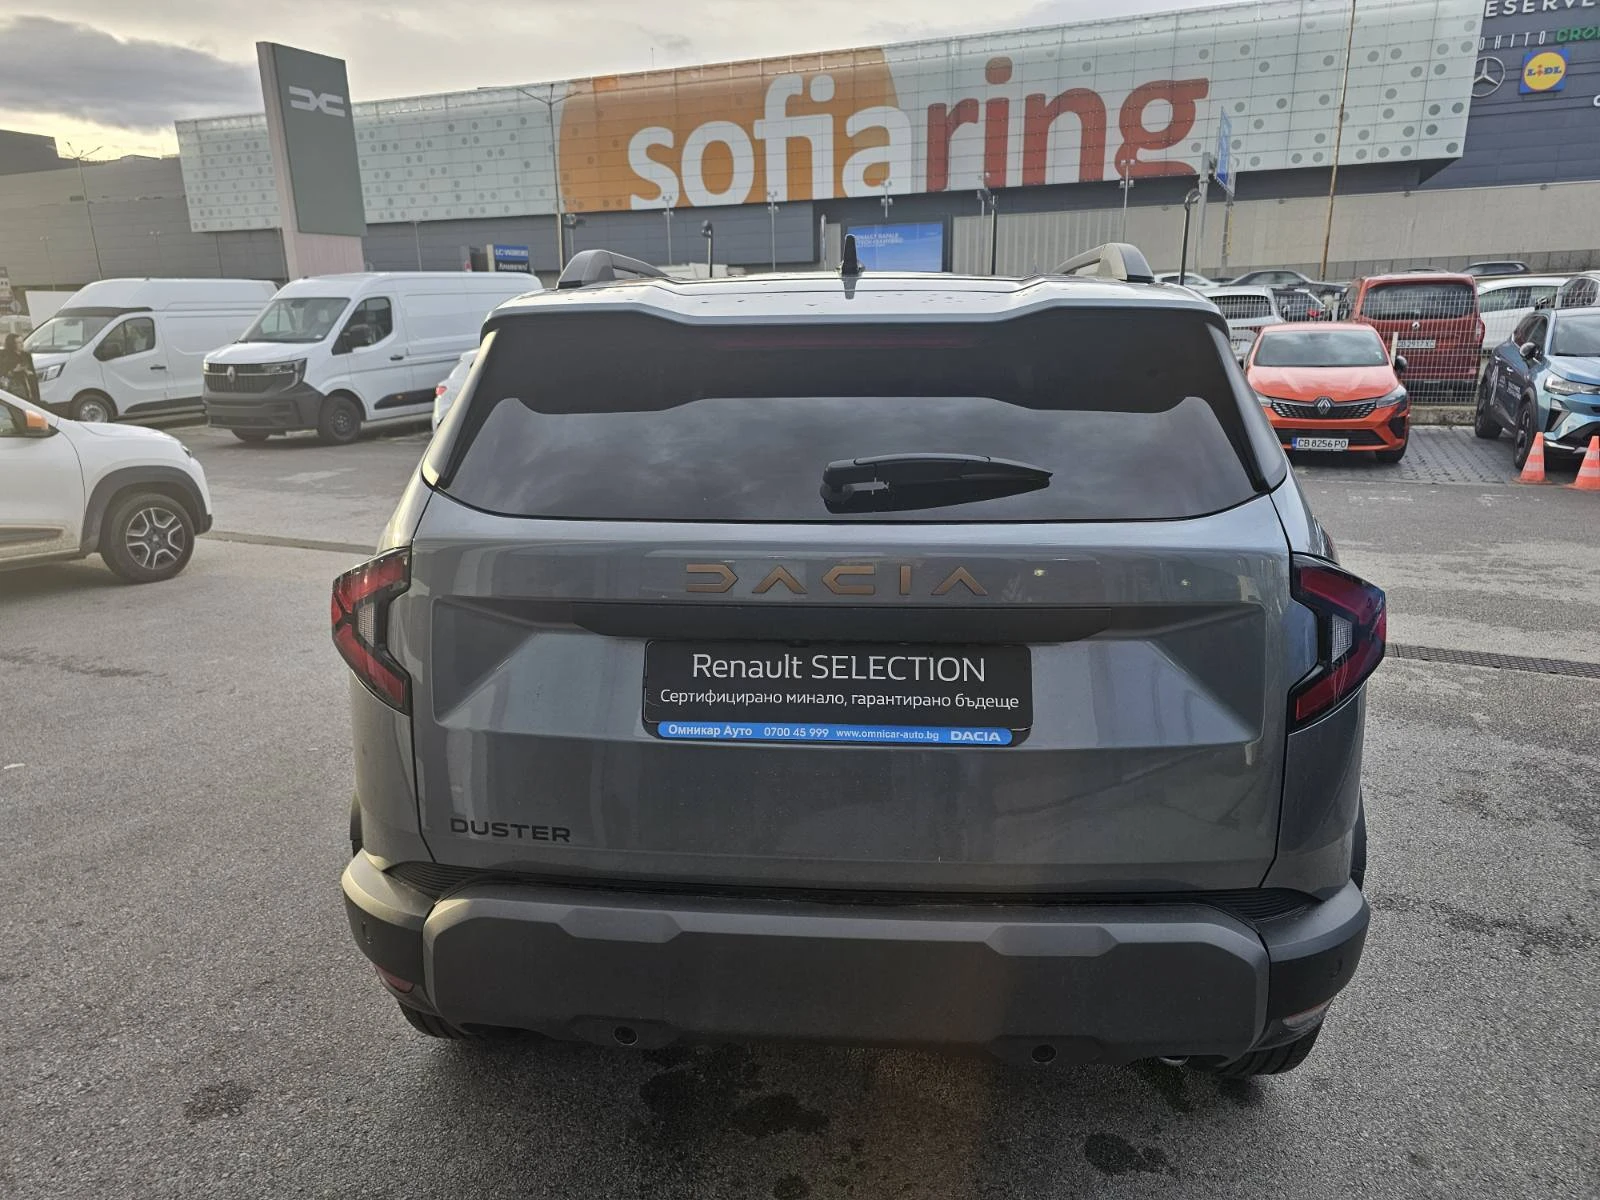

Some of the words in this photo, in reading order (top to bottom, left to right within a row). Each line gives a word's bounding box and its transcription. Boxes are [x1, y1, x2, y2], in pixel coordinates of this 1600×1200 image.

[1298, 439, 1310, 448] CB
[1311, 439, 1333, 448] 8256
[686, 563, 989, 596] DACIA
[692, 653, 803, 679] Renault
[811, 654, 985, 682] SELECTION
[660, 688, 783, 706] Сертифицирано
[786, 692, 848, 707] минало,
[851, 693, 951, 709] гарантирано
[955, 693, 1020, 710] бъдеще
[668, 724, 721, 738] Омникар
[723, 725, 753, 739] Ауто
[764, 727, 790, 737] 0700
[793, 727, 806, 737] 45
[809, 728, 829, 738] 999
[836, 729, 940, 742] www.omnicar-auto.bg
[951, 730, 1001, 742] DACIA
[450, 817, 571, 843] DUSTER
